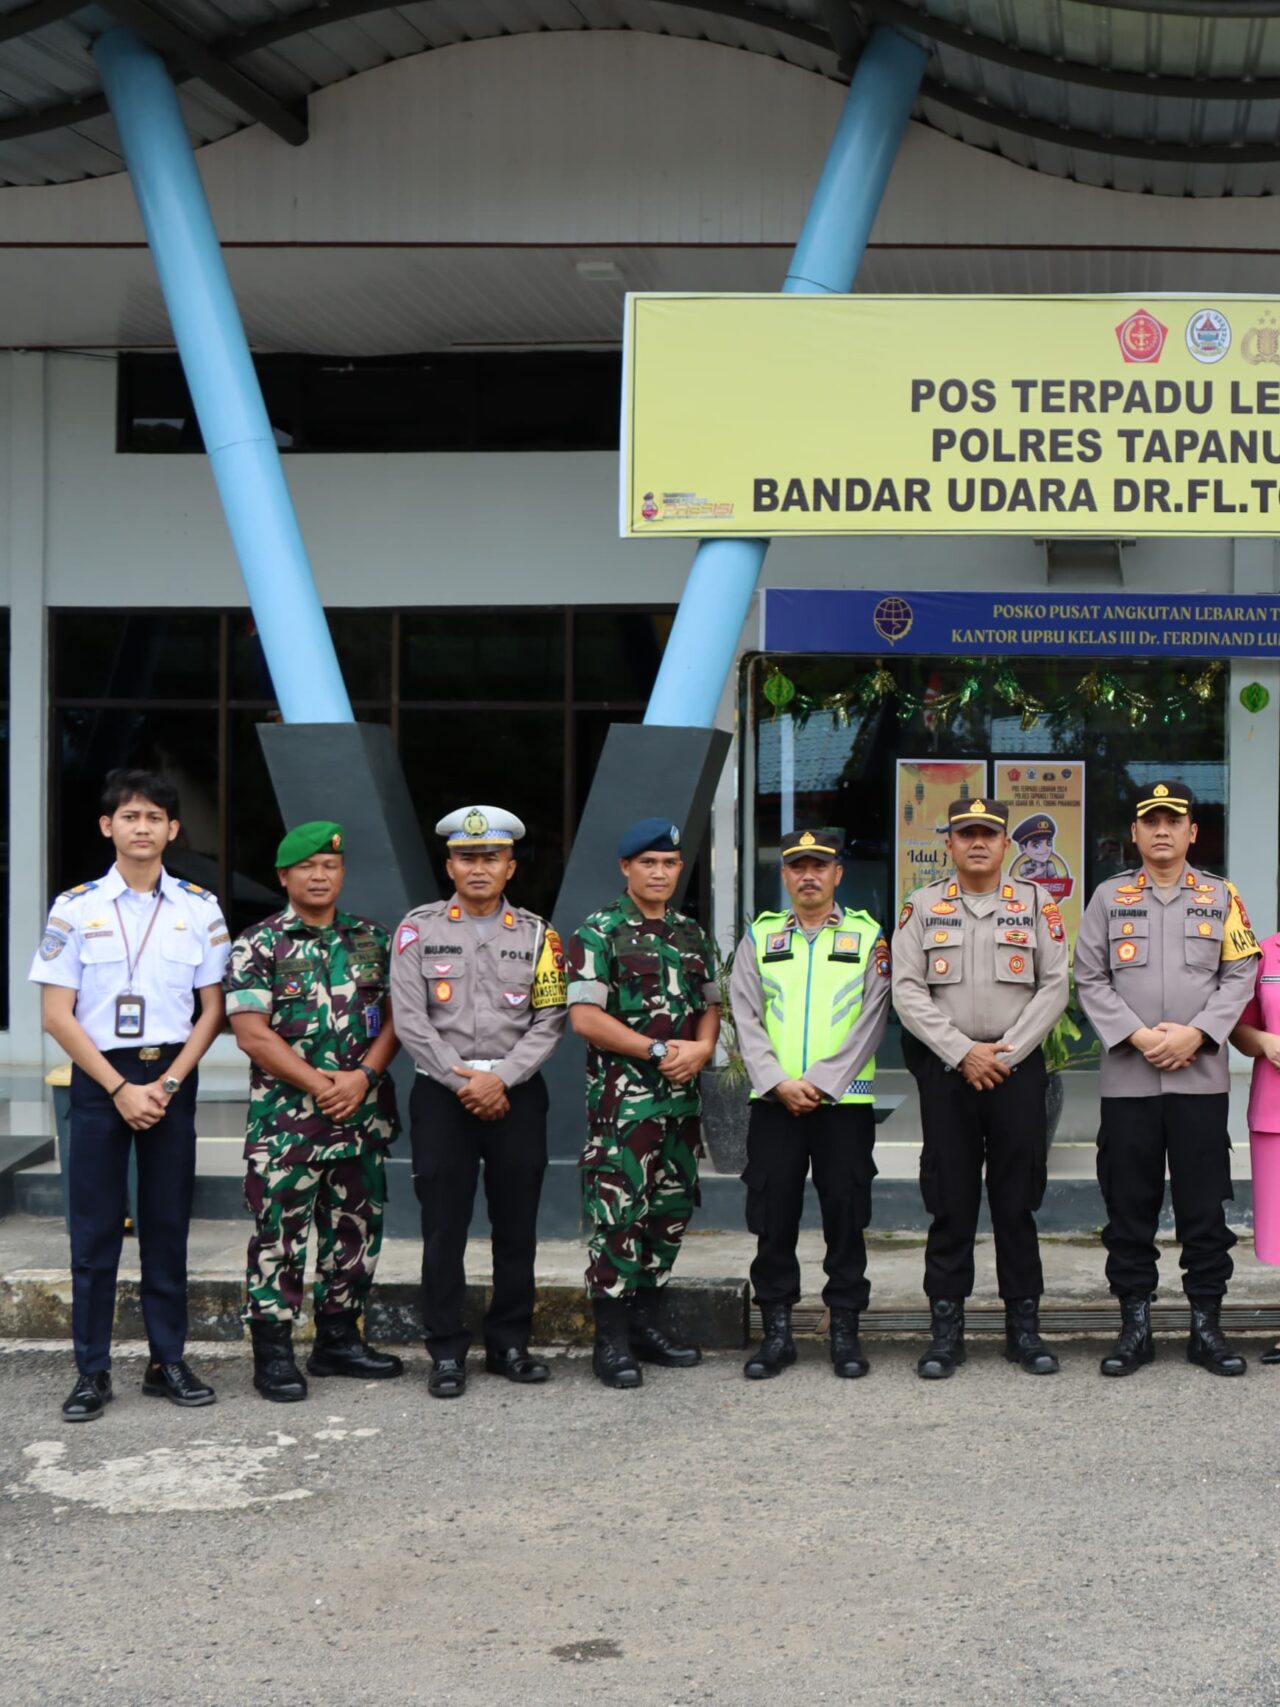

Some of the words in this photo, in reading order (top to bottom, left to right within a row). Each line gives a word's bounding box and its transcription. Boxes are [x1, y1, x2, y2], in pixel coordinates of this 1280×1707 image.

[911, 378, 997, 413] POS
[1011, 379, 1213, 415] TERPADU
[932, 428, 1102, 463] POLRES
[753, 477, 932, 512] BANDAR
[947, 478, 1098, 513] UDARA
[993, 604, 1046, 619] POSKO
[1050, 605, 1100, 619] PUSAT
[1103, 606, 1192, 620] ANGKUTAN
[1195, 607, 1268, 621] LEBARAN
[951, 629, 1018, 643] KANTOR
[1021, 630, 1065, 644] UPBU
[1067, 631, 1117, 645] KELAS
[1119, 632, 1136, 645] III
[1138, 632, 1160, 645] Dr.
[1163, 632, 1255, 647] FERDINAND
[907, 849, 938, 863] Idul
[1186, 907, 1223, 918] POLRI
[997, 917, 1034, 928] POLRI
[501, 950, 533, 961] POLR
